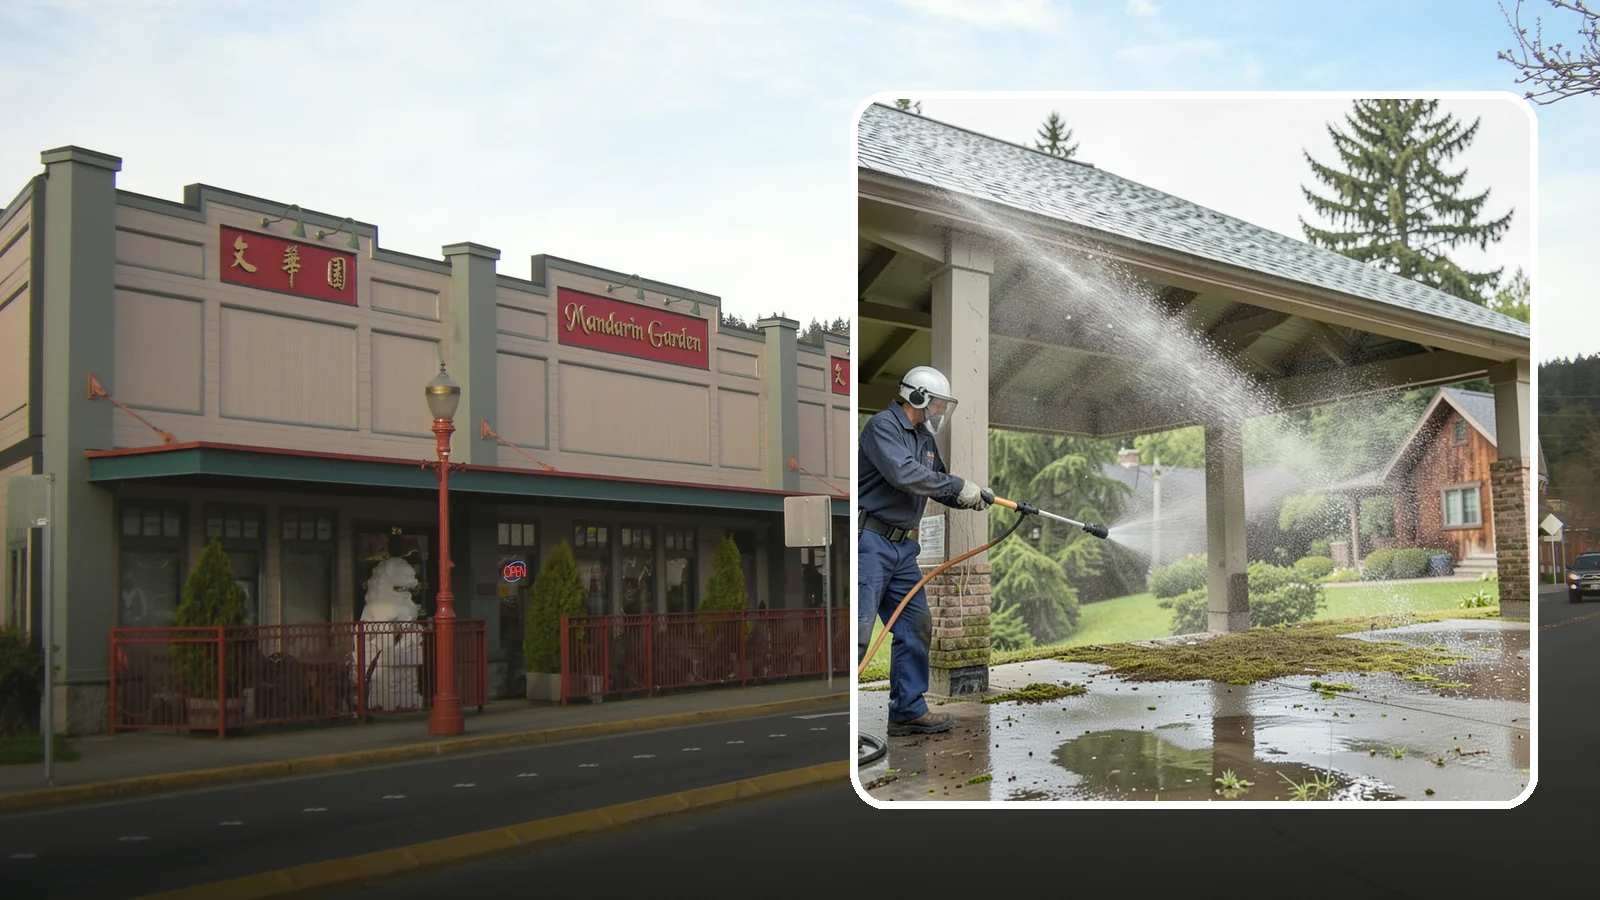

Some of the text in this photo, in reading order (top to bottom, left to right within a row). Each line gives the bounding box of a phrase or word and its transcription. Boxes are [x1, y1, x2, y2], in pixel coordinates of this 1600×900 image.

[231, 236, 347, 291] 文華園
[564, 302, 701, 352] Mandarin Garden
[503, 565, 527, 578] OPEN
